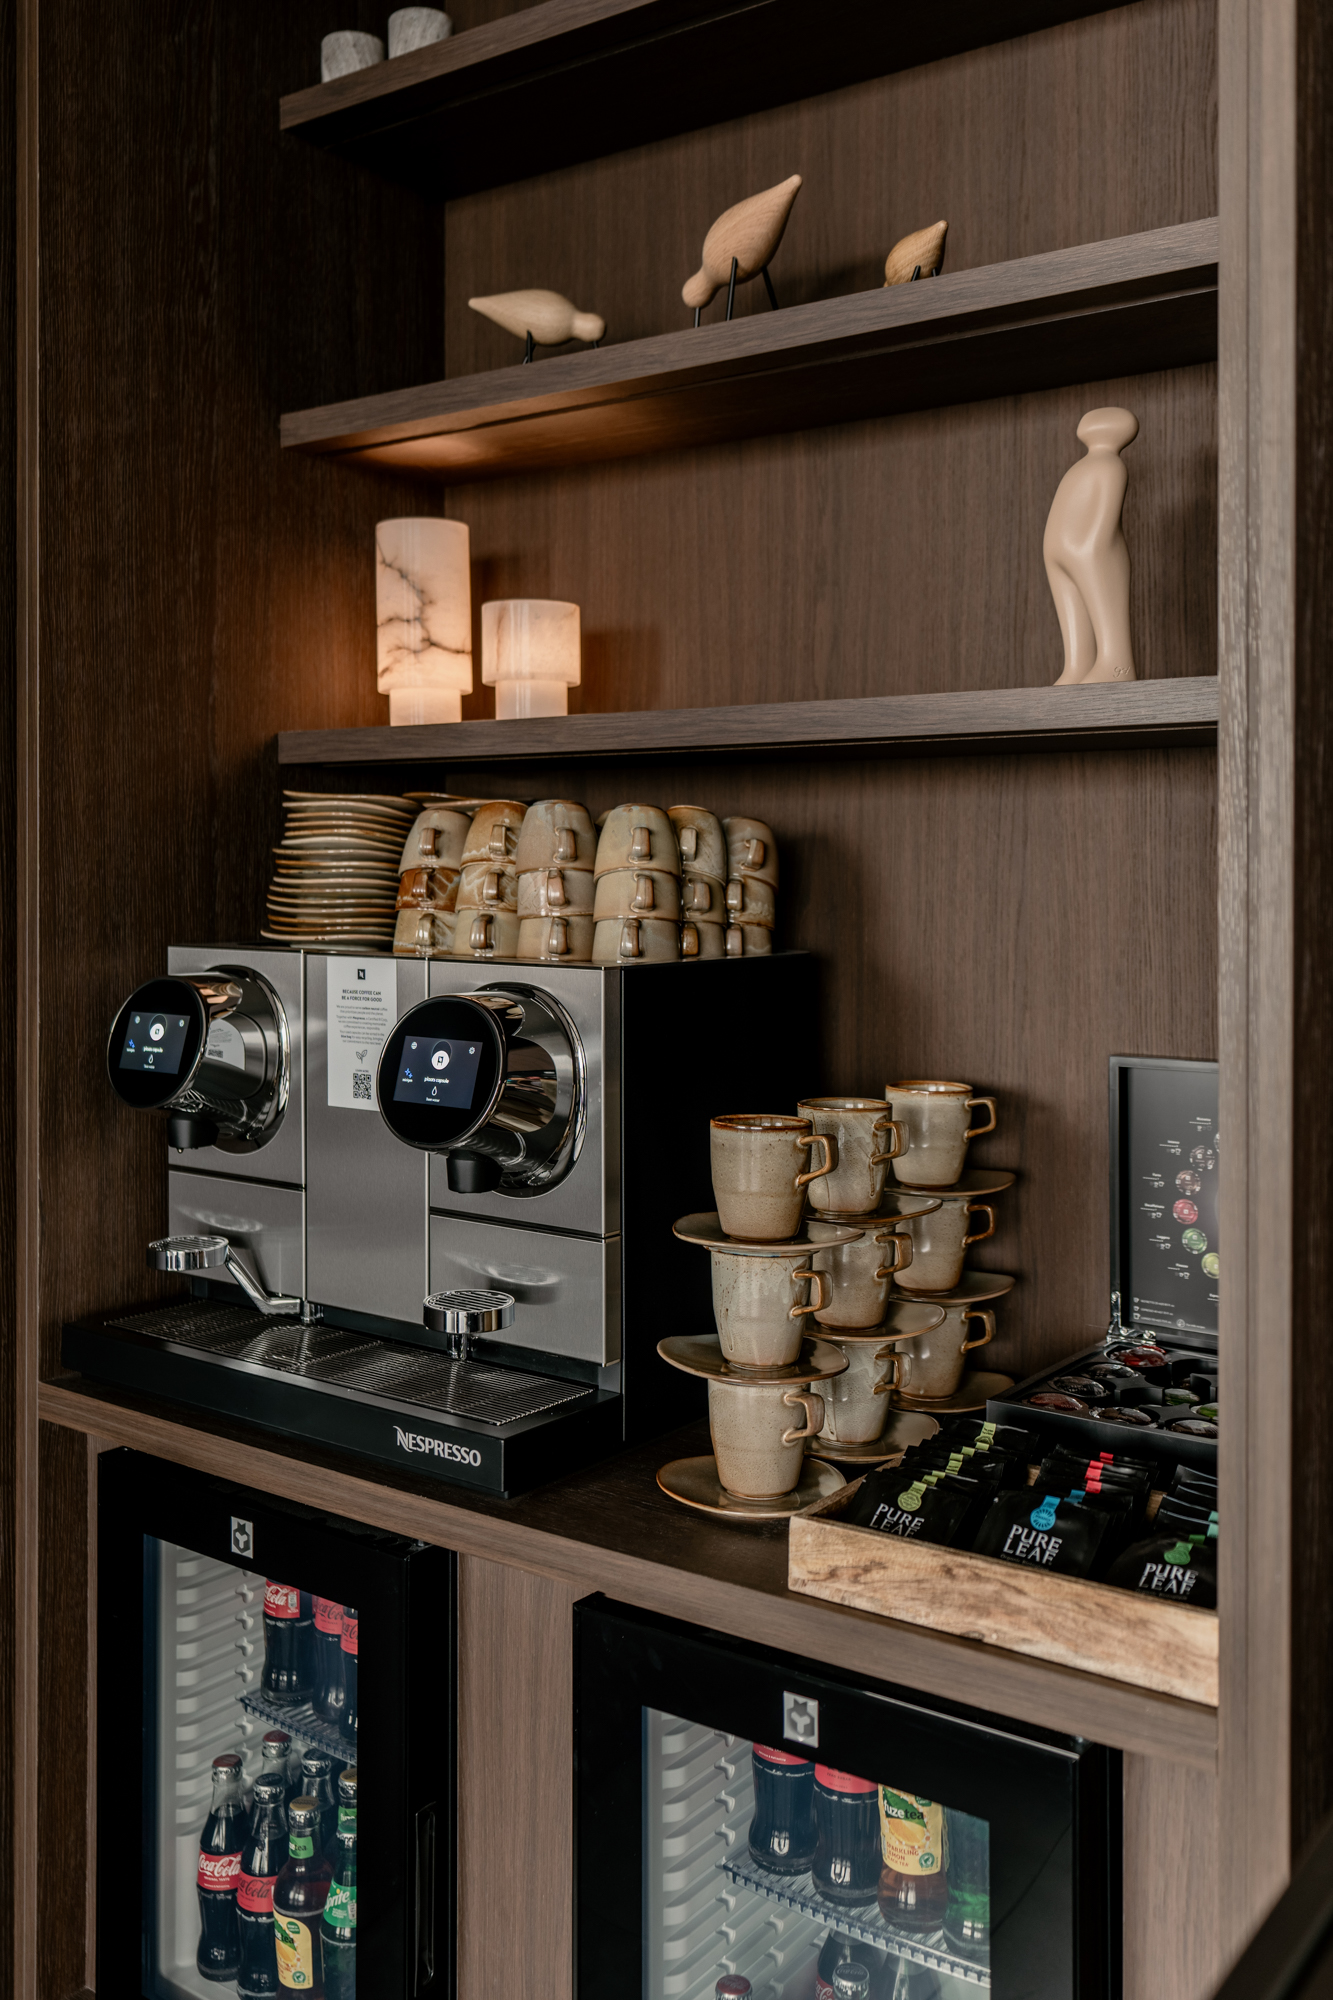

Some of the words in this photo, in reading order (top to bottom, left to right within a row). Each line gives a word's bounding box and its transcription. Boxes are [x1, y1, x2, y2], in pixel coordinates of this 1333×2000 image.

[392, 1426, 481, 1467] NESPRESSO
[869, 1515, 918, 1537] LEAF
[875, 1502, 925, 1529] PURE
[1008, 1524, 1063, 1551] PURE
[1003, 1537, 1059, 1564] LEAF
[1138, 1575, 1194, 1594] LEAF
[1143, 1562, 1199, 1583] PURE
[198, 1854, 241, 1877] Coca-Cola
